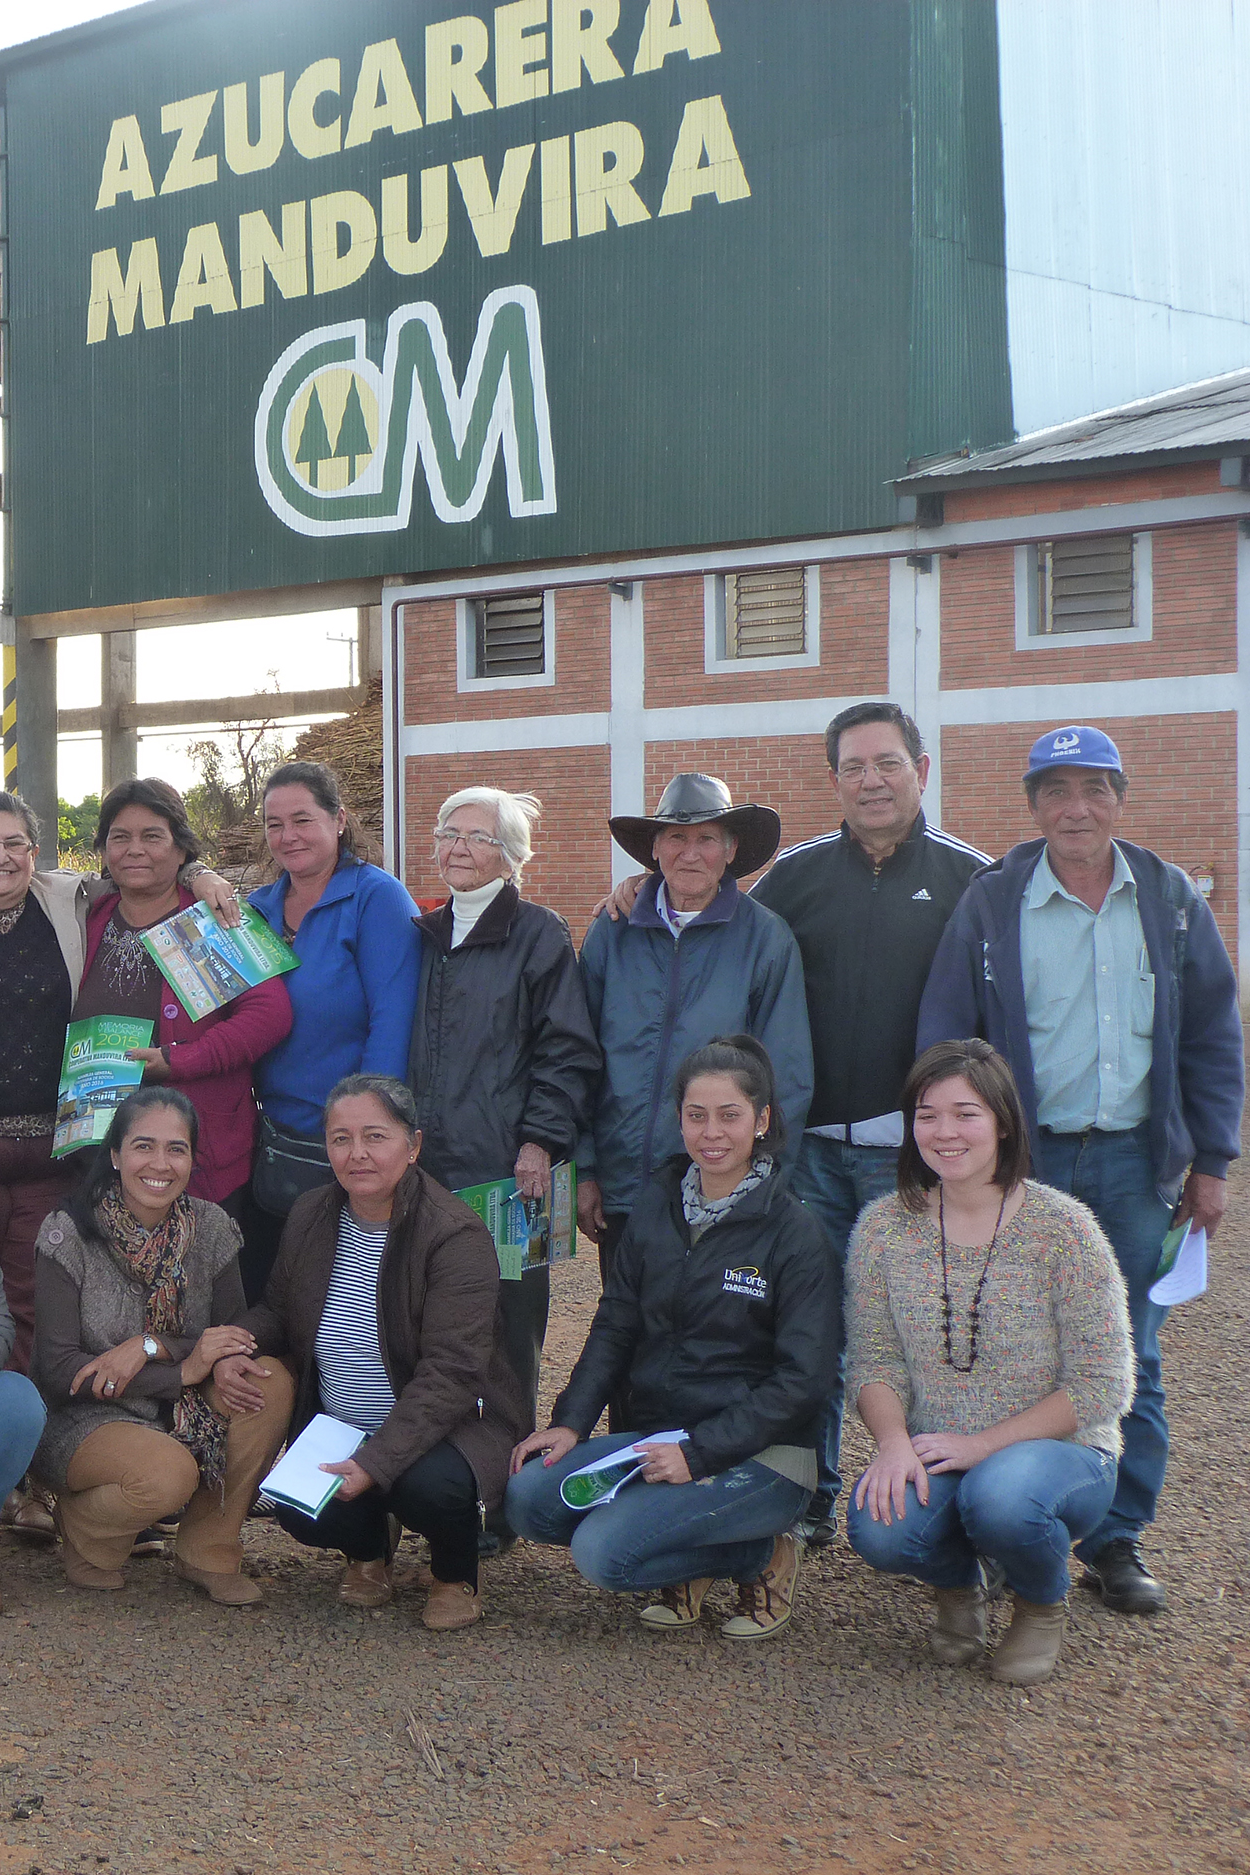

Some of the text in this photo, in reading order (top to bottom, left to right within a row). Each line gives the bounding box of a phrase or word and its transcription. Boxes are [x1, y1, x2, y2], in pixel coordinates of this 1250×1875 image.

[96, 0, 722, 211] AZUCARERA
[87, 95, 751, 345] MANDUVIRA
[220, 944, 233, 959] 2016
[252, 928, 282, 965] 2015
[98, 1021, 145, 1033] MEMORIA
[96, 1033, 140, 1049] 2015
